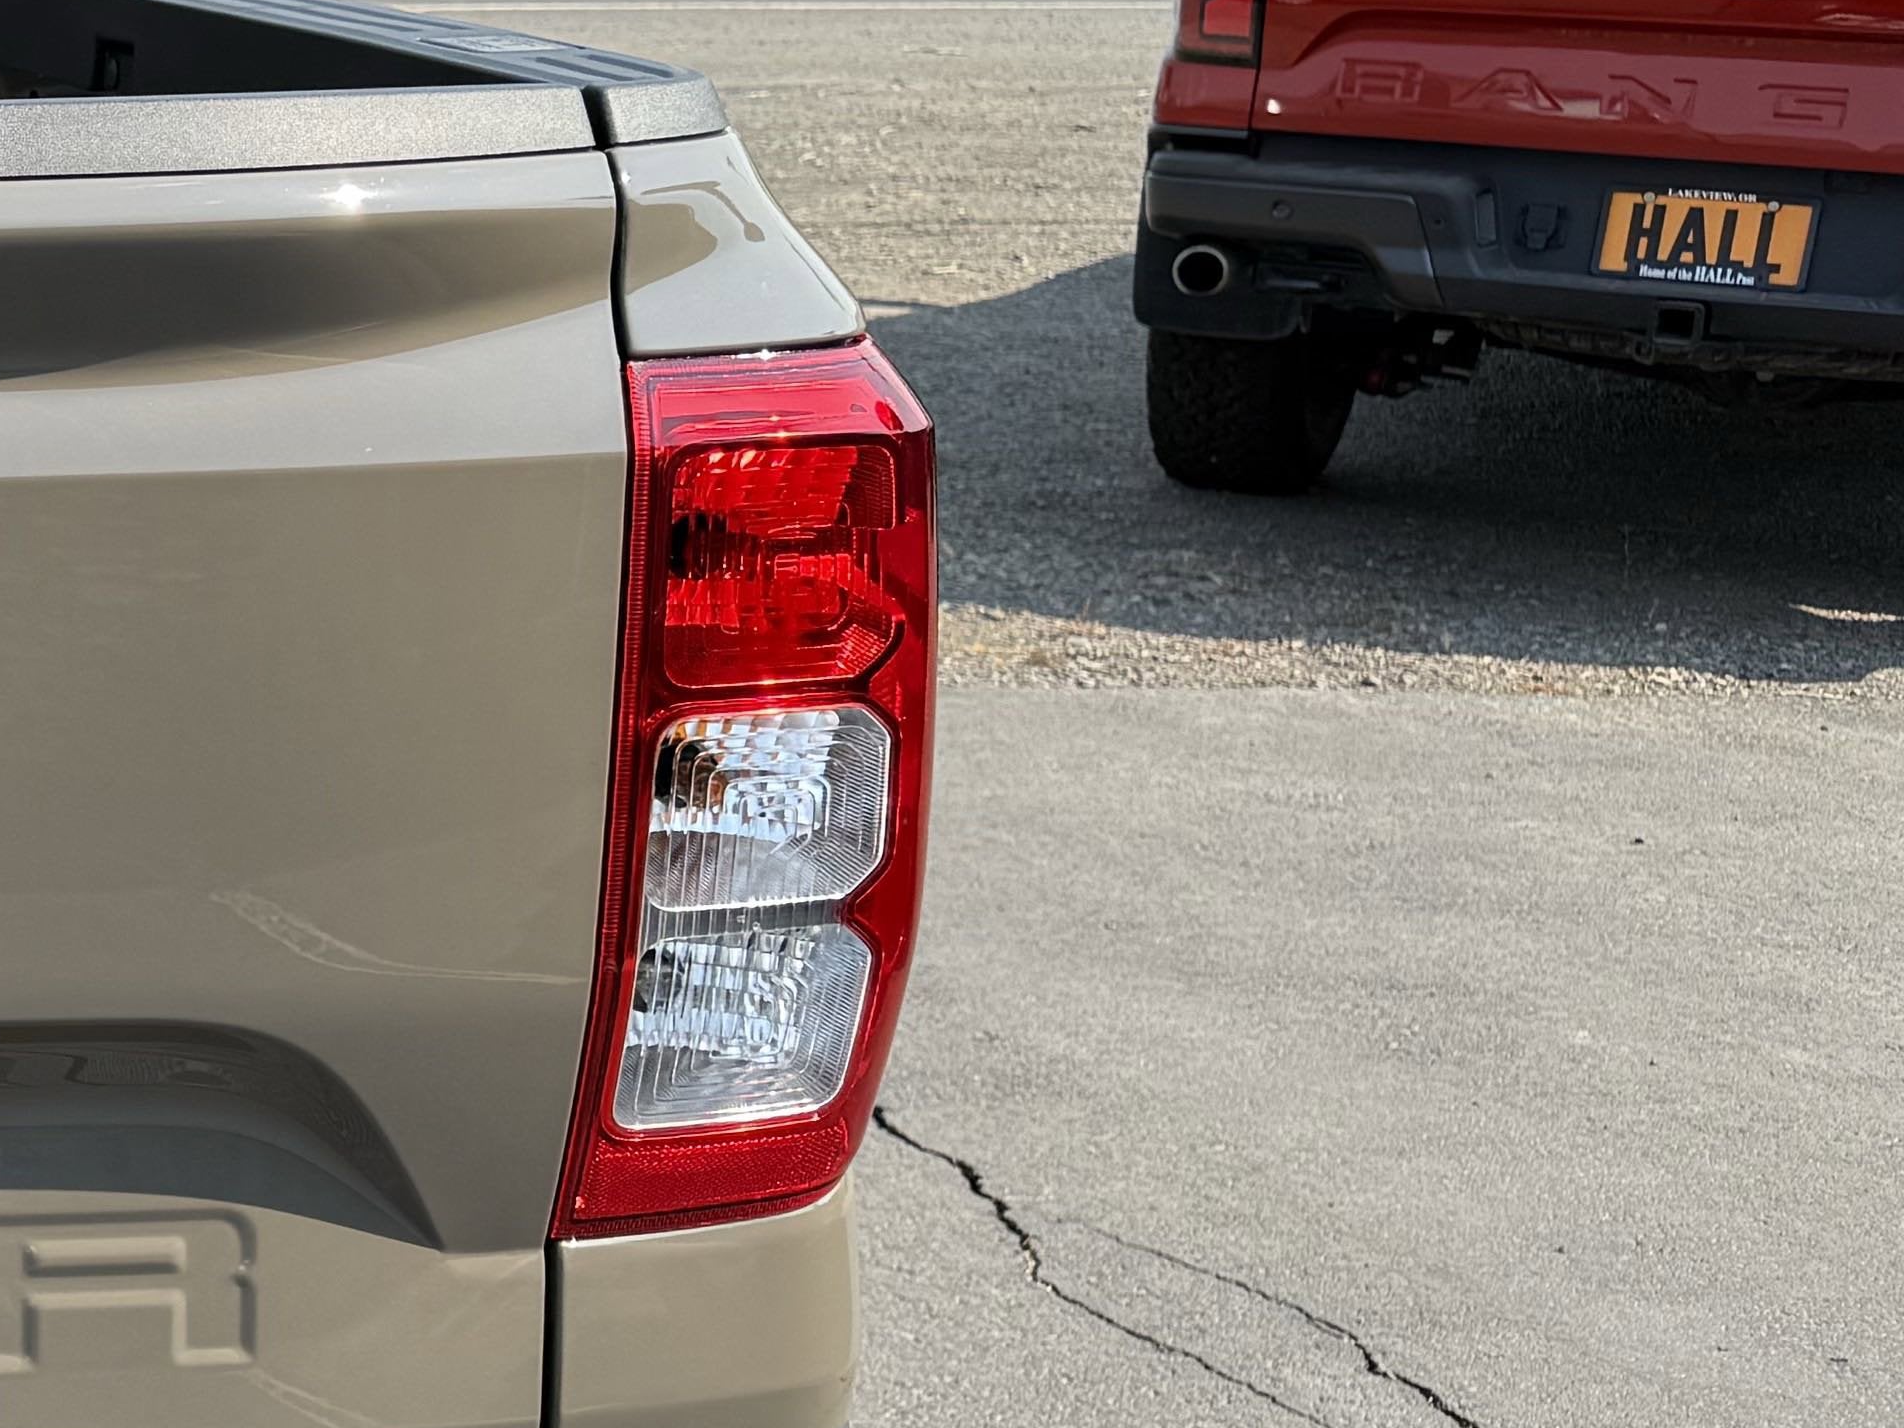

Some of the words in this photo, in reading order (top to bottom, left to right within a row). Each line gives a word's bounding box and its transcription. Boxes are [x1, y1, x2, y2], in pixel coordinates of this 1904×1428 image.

[1335, 57, 1850, 128] RANG
[1624, 201, 1781, 275] HALL
[1639, 264, 1666, 280] Home
[1667, 267, 1678, 280] of
[1678, 268, 1693, 282] the
[1694, 266, 1735, 285] HALL
